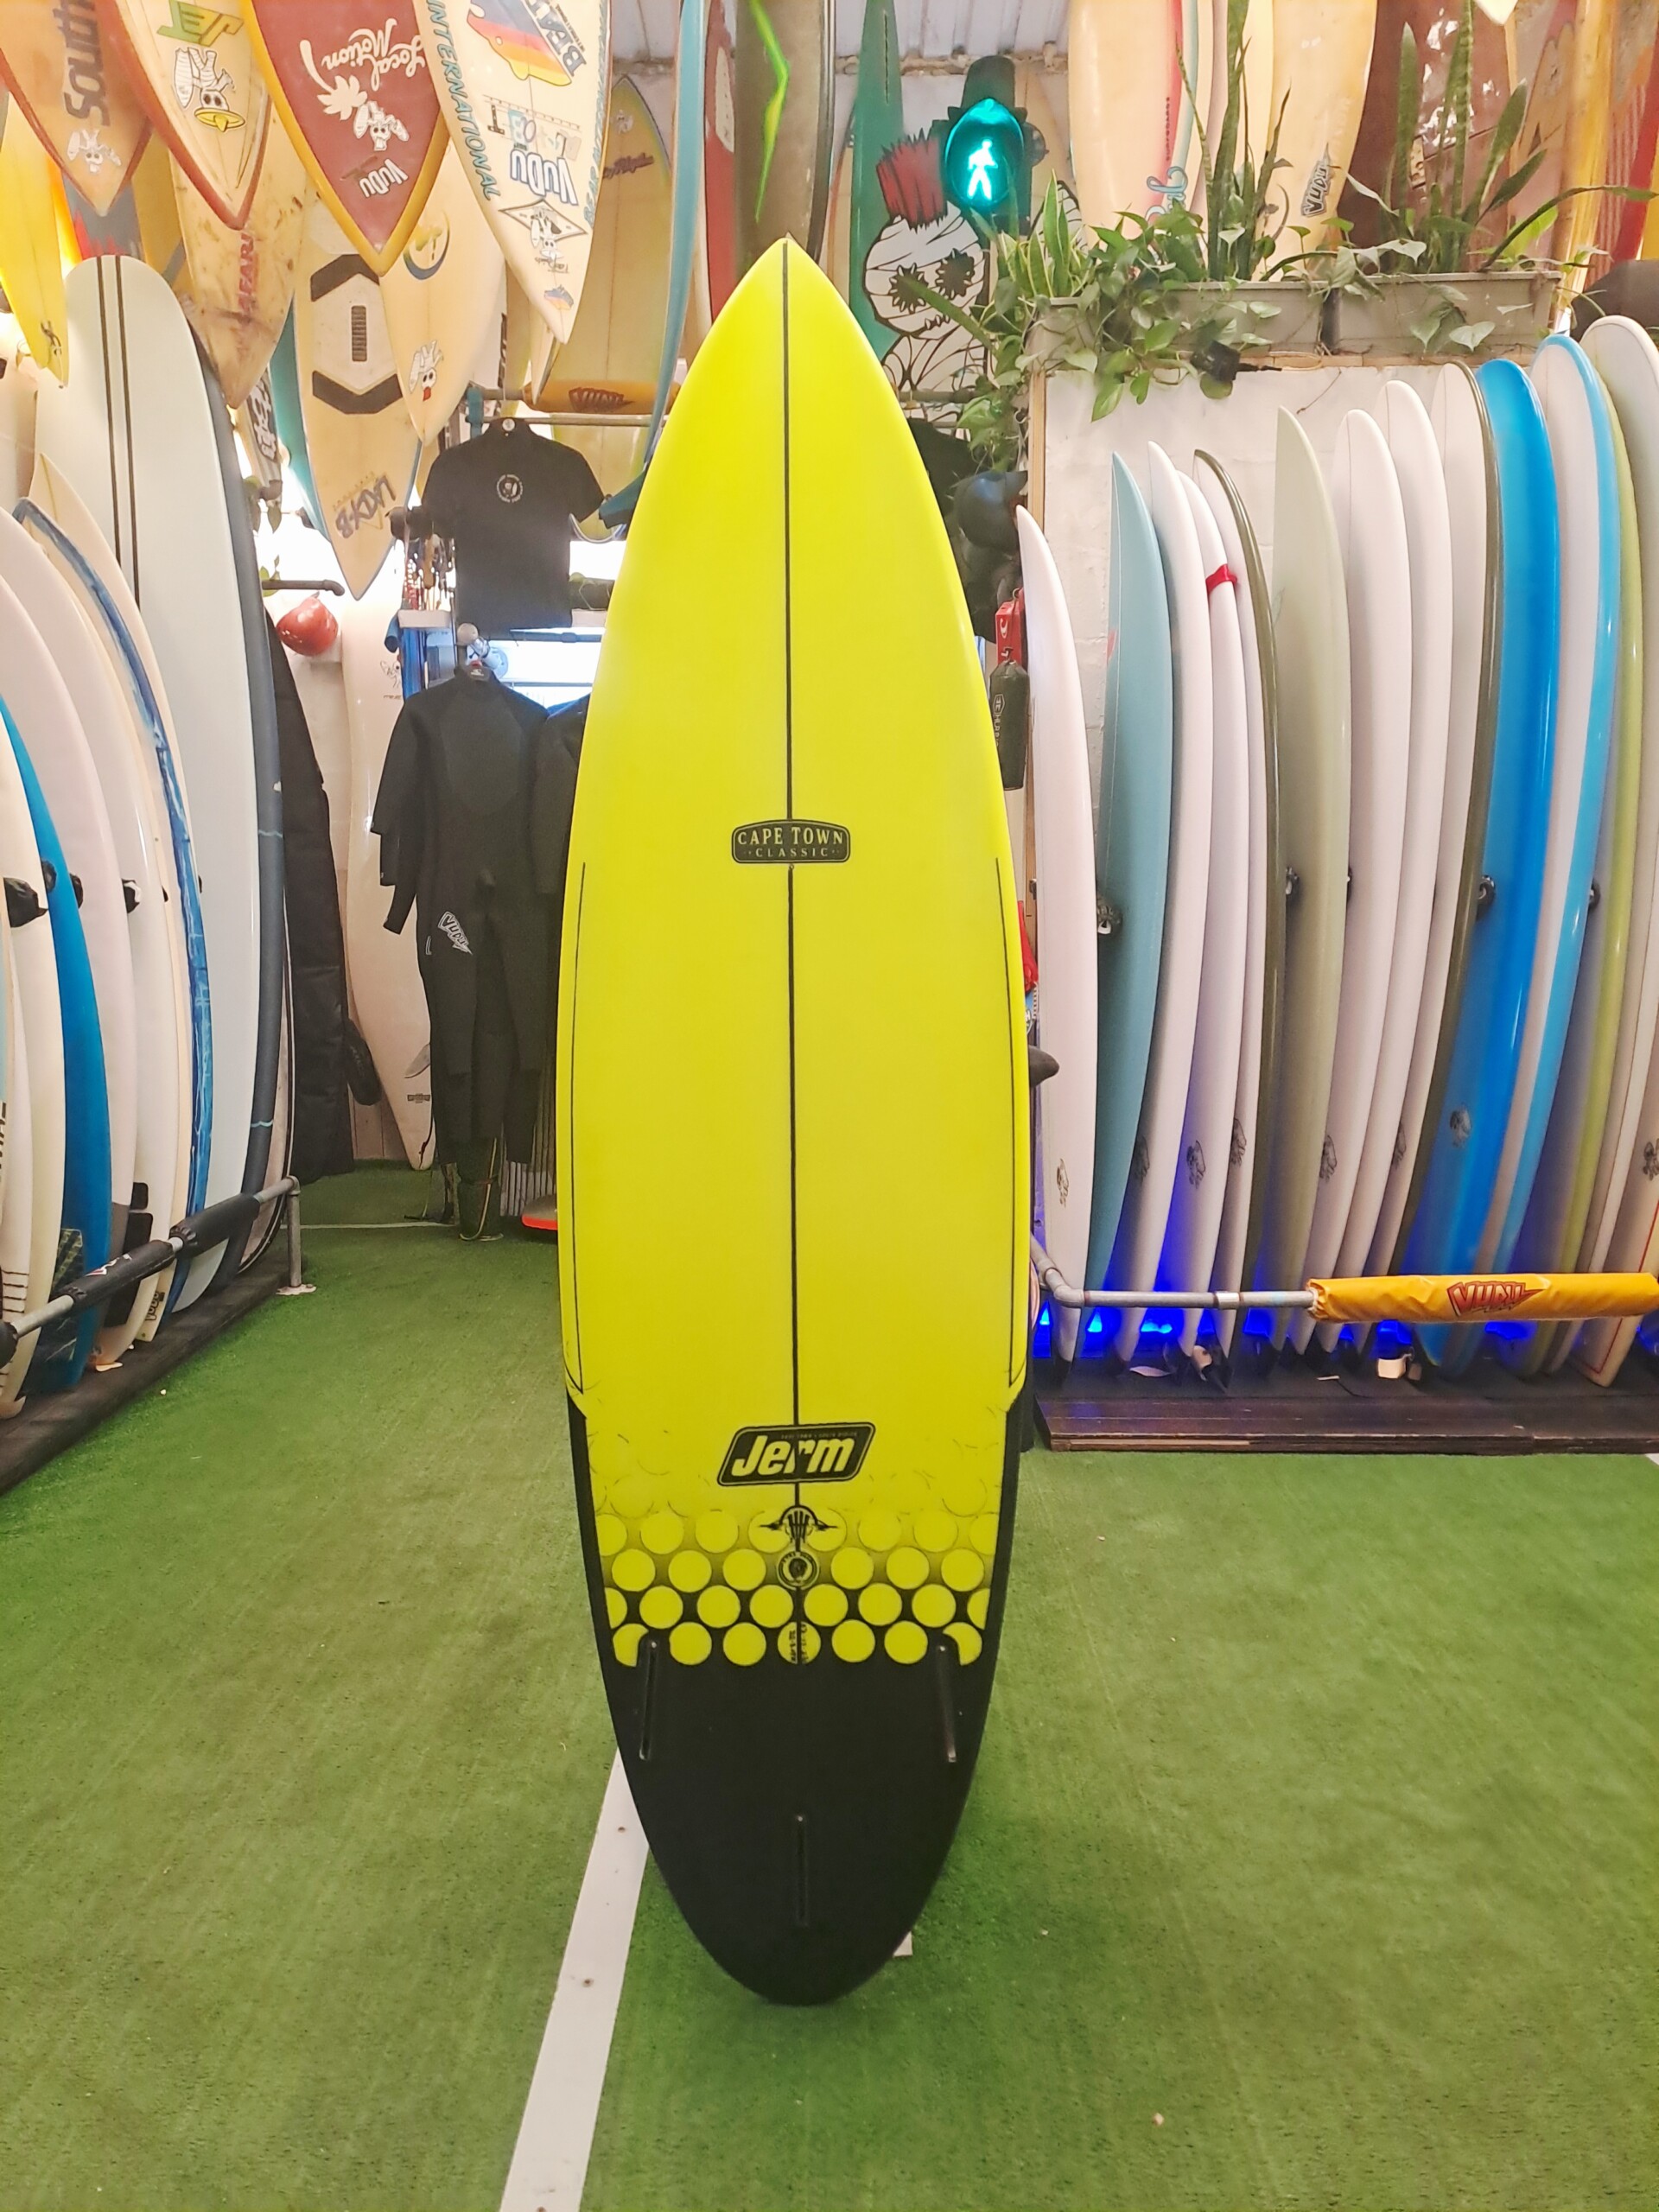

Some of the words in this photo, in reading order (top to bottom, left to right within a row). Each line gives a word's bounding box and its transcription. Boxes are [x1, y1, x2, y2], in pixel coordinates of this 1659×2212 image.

[321, 17, 397, 71] Motion
[362, 35, 425, 92] Local
[1302, 163, 1328, 214] VUDU
[737, 827, 783, 845] CAPE
[791, 827, 843, 845] TOWN
[755, 848, 828, 857] CLASSIC
[438, 912, 469, 948] VUDU
[1449, 1282, 1528, 1315] VUDU
[731, 1434, 855, 1477] Jerm
